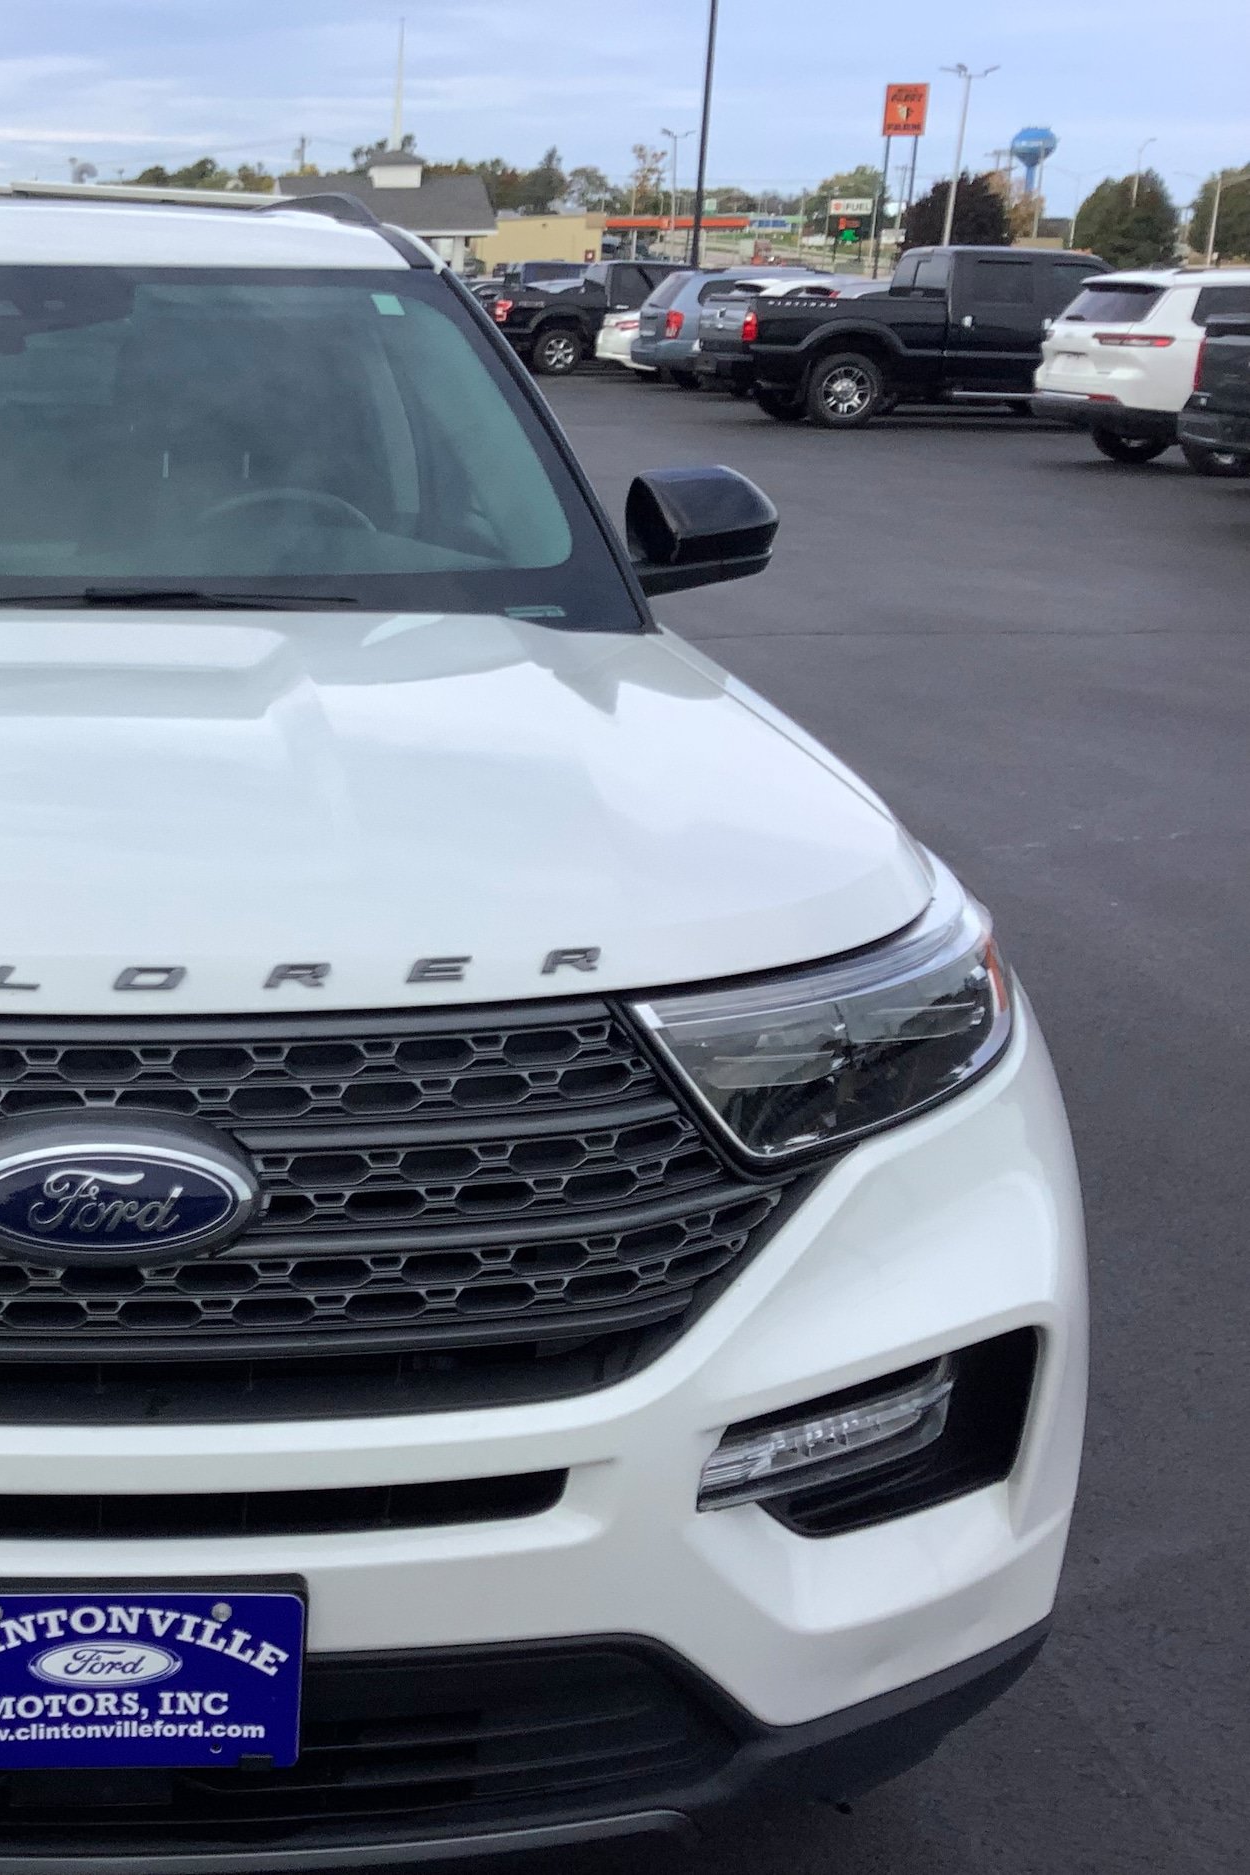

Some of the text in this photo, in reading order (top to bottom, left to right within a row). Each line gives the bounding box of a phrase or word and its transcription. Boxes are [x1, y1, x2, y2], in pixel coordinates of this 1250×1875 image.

[28, 1169, 183, 1233] Ford
[63, 1648, 144, 1677] Ford
[158, 1692, 229, 1716] INC
